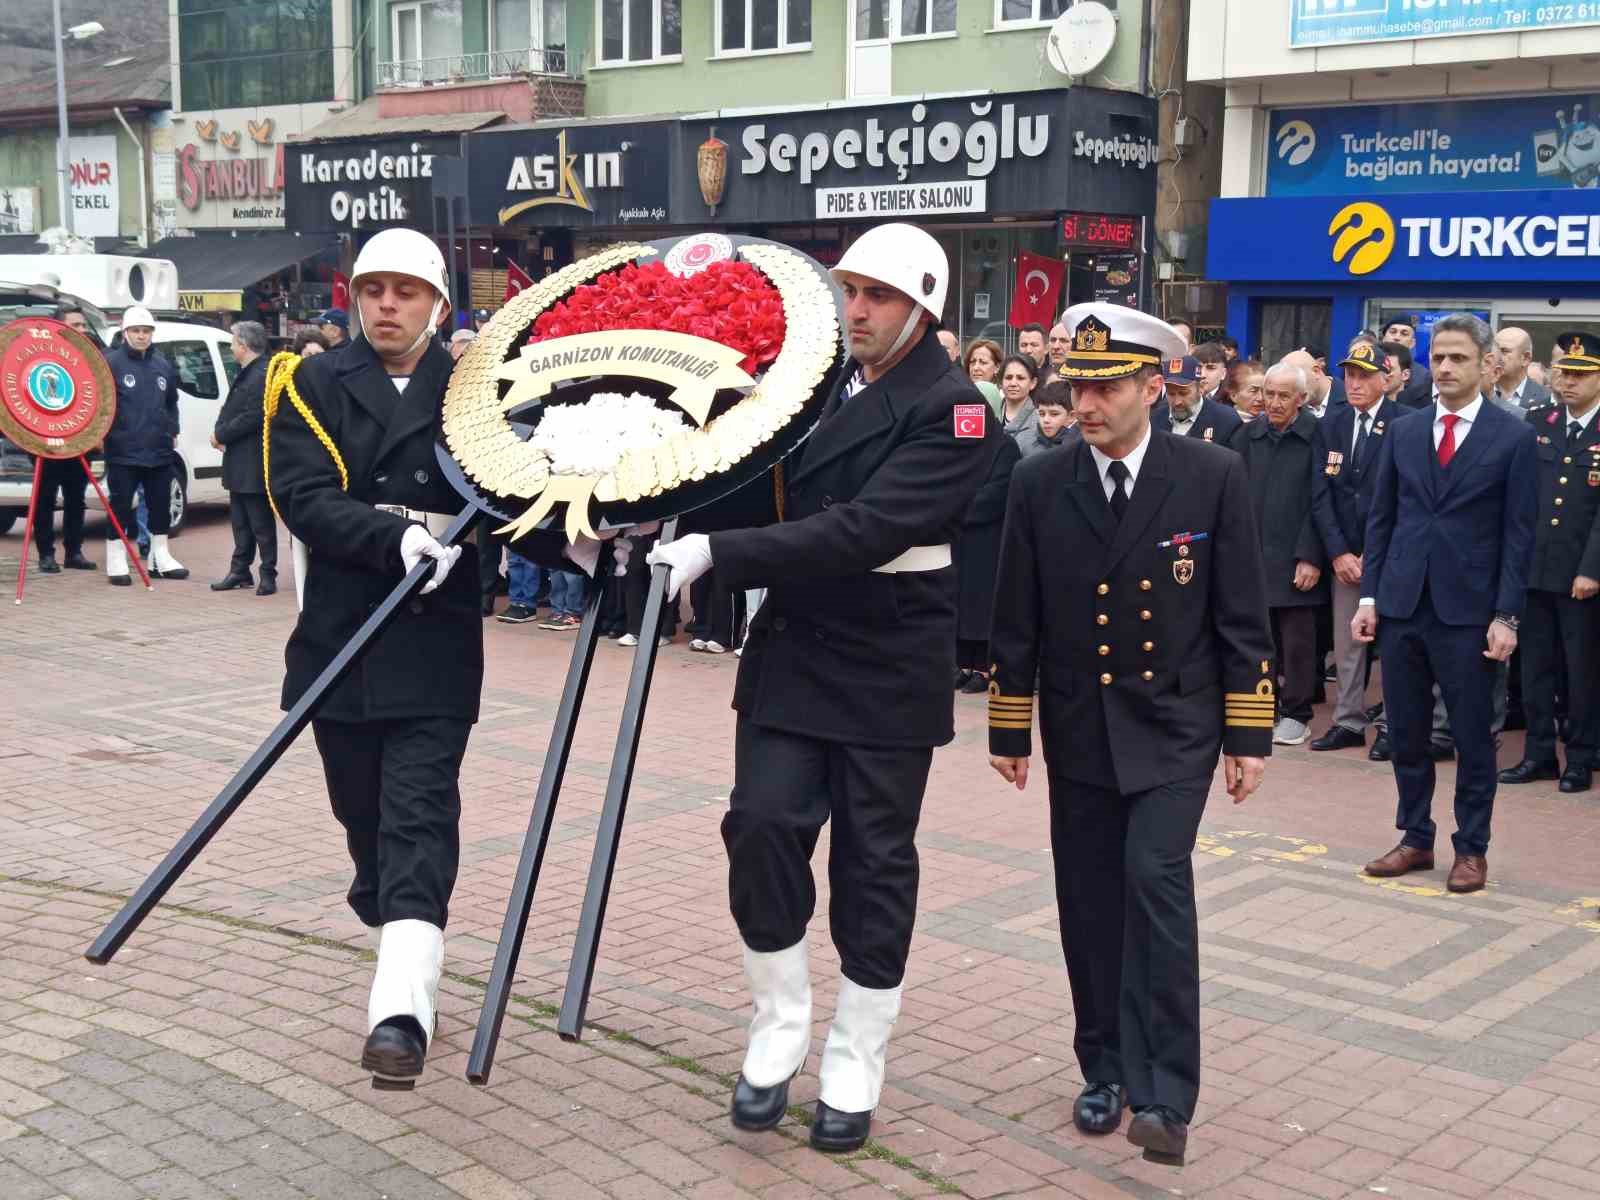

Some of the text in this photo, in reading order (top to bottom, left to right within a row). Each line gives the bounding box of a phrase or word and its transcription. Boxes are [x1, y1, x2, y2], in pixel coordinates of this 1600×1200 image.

[1504, 9, 1531, 24] Tel:
[1536, 5, 1574, 21] 0372
[742, 101, 1048, 184] Sepetçioğlu
[1074, 130, 1159, 169] Sepetçioğlu
[1341, 129, 1451, 154] Turkcell'le
[301, 143, 433, 183] Karadeniz
[1345, 155, 1423, 181] bağlan
[1429, 151, 1521, 179] hayata!
[71, 194, 110, 209] EKEL
[330, 185, 404, 228] Optik
[858, 192, 867, 211] &
[871, 189, 916, 210] YEMEK
[919, 186, 973, 208] SALONU
[1402, 216, 1600, 256] TURKCEL
[178, 295, 205, 310] AVM
[529, 345, 720, 380] GARNİZON KOMUTANLIĞI
